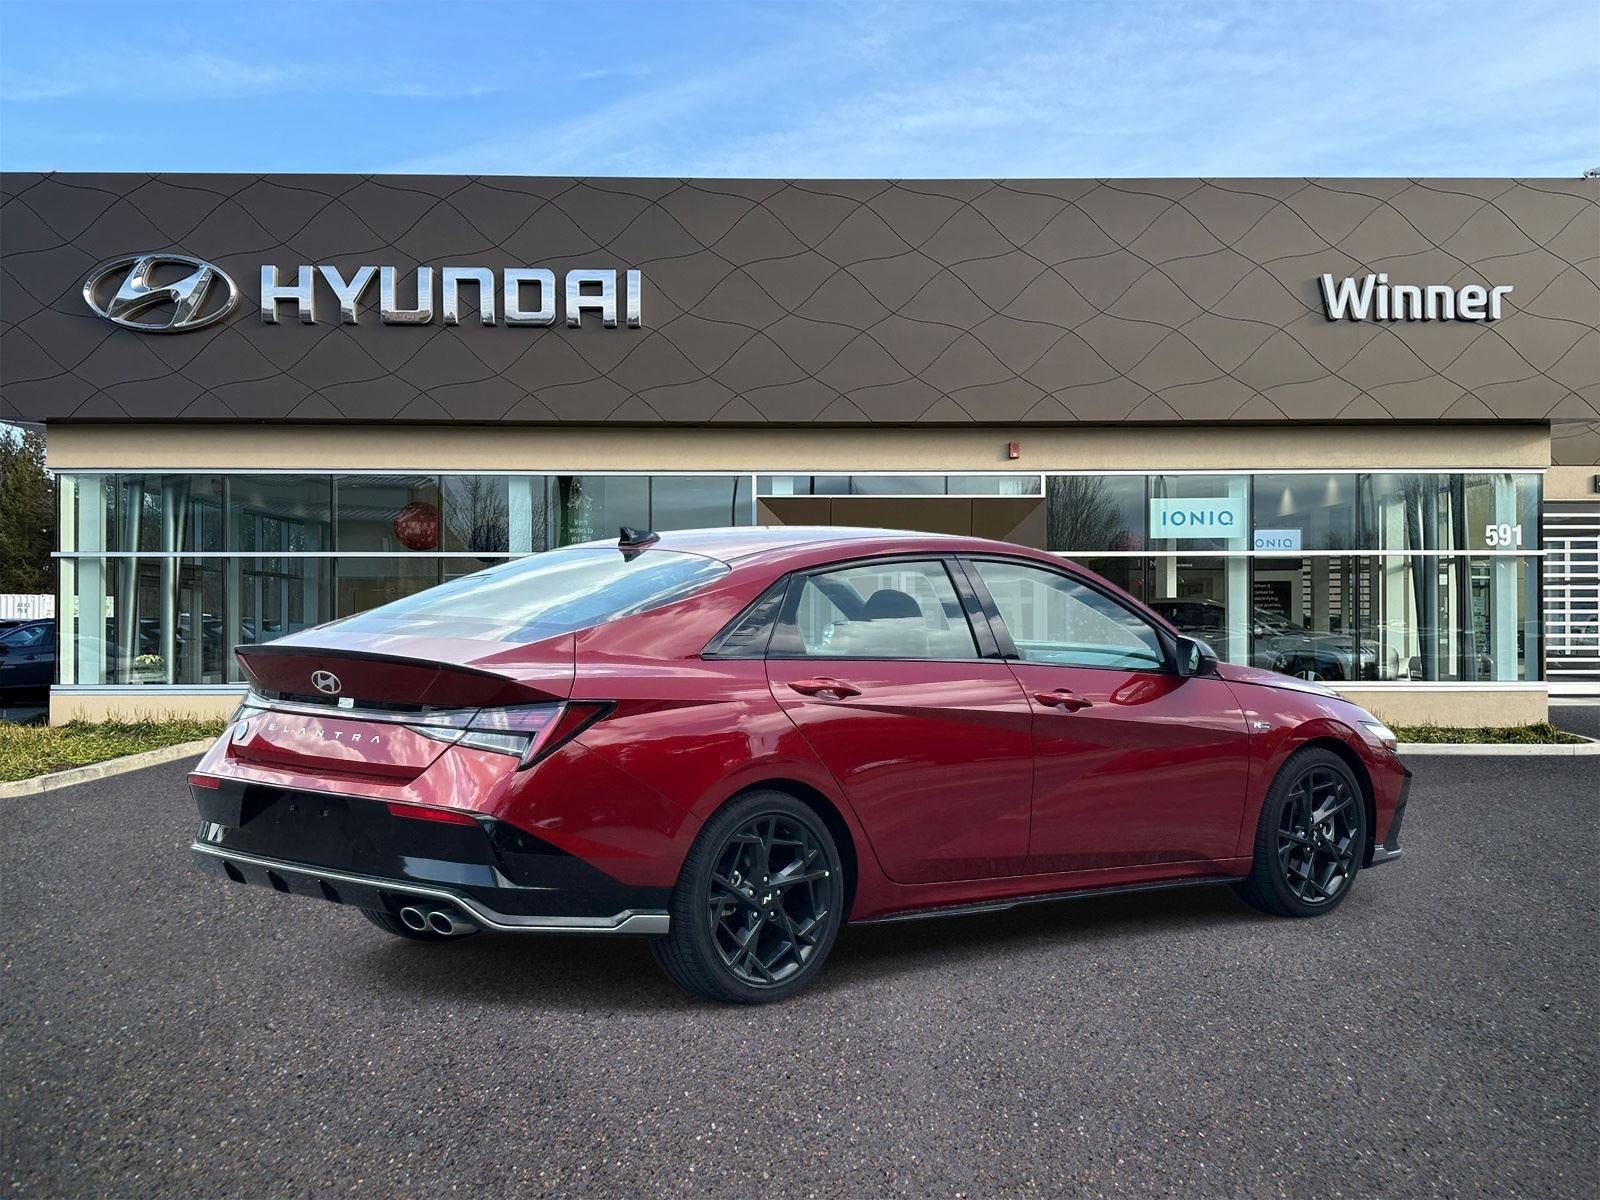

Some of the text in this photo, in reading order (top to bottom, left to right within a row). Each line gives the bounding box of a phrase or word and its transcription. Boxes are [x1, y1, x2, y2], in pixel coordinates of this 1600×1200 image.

[260, 265, 643, 328] HYUNDAI
[1319, 272, 1514, 321] Winner
[1161, 510, 1234, 526] IONIQ
[1255, 538, 1293, 548] ONIQ
[1485, 523, 1522, 546] 591
[268, 723, 381, 743] ELANTRA
